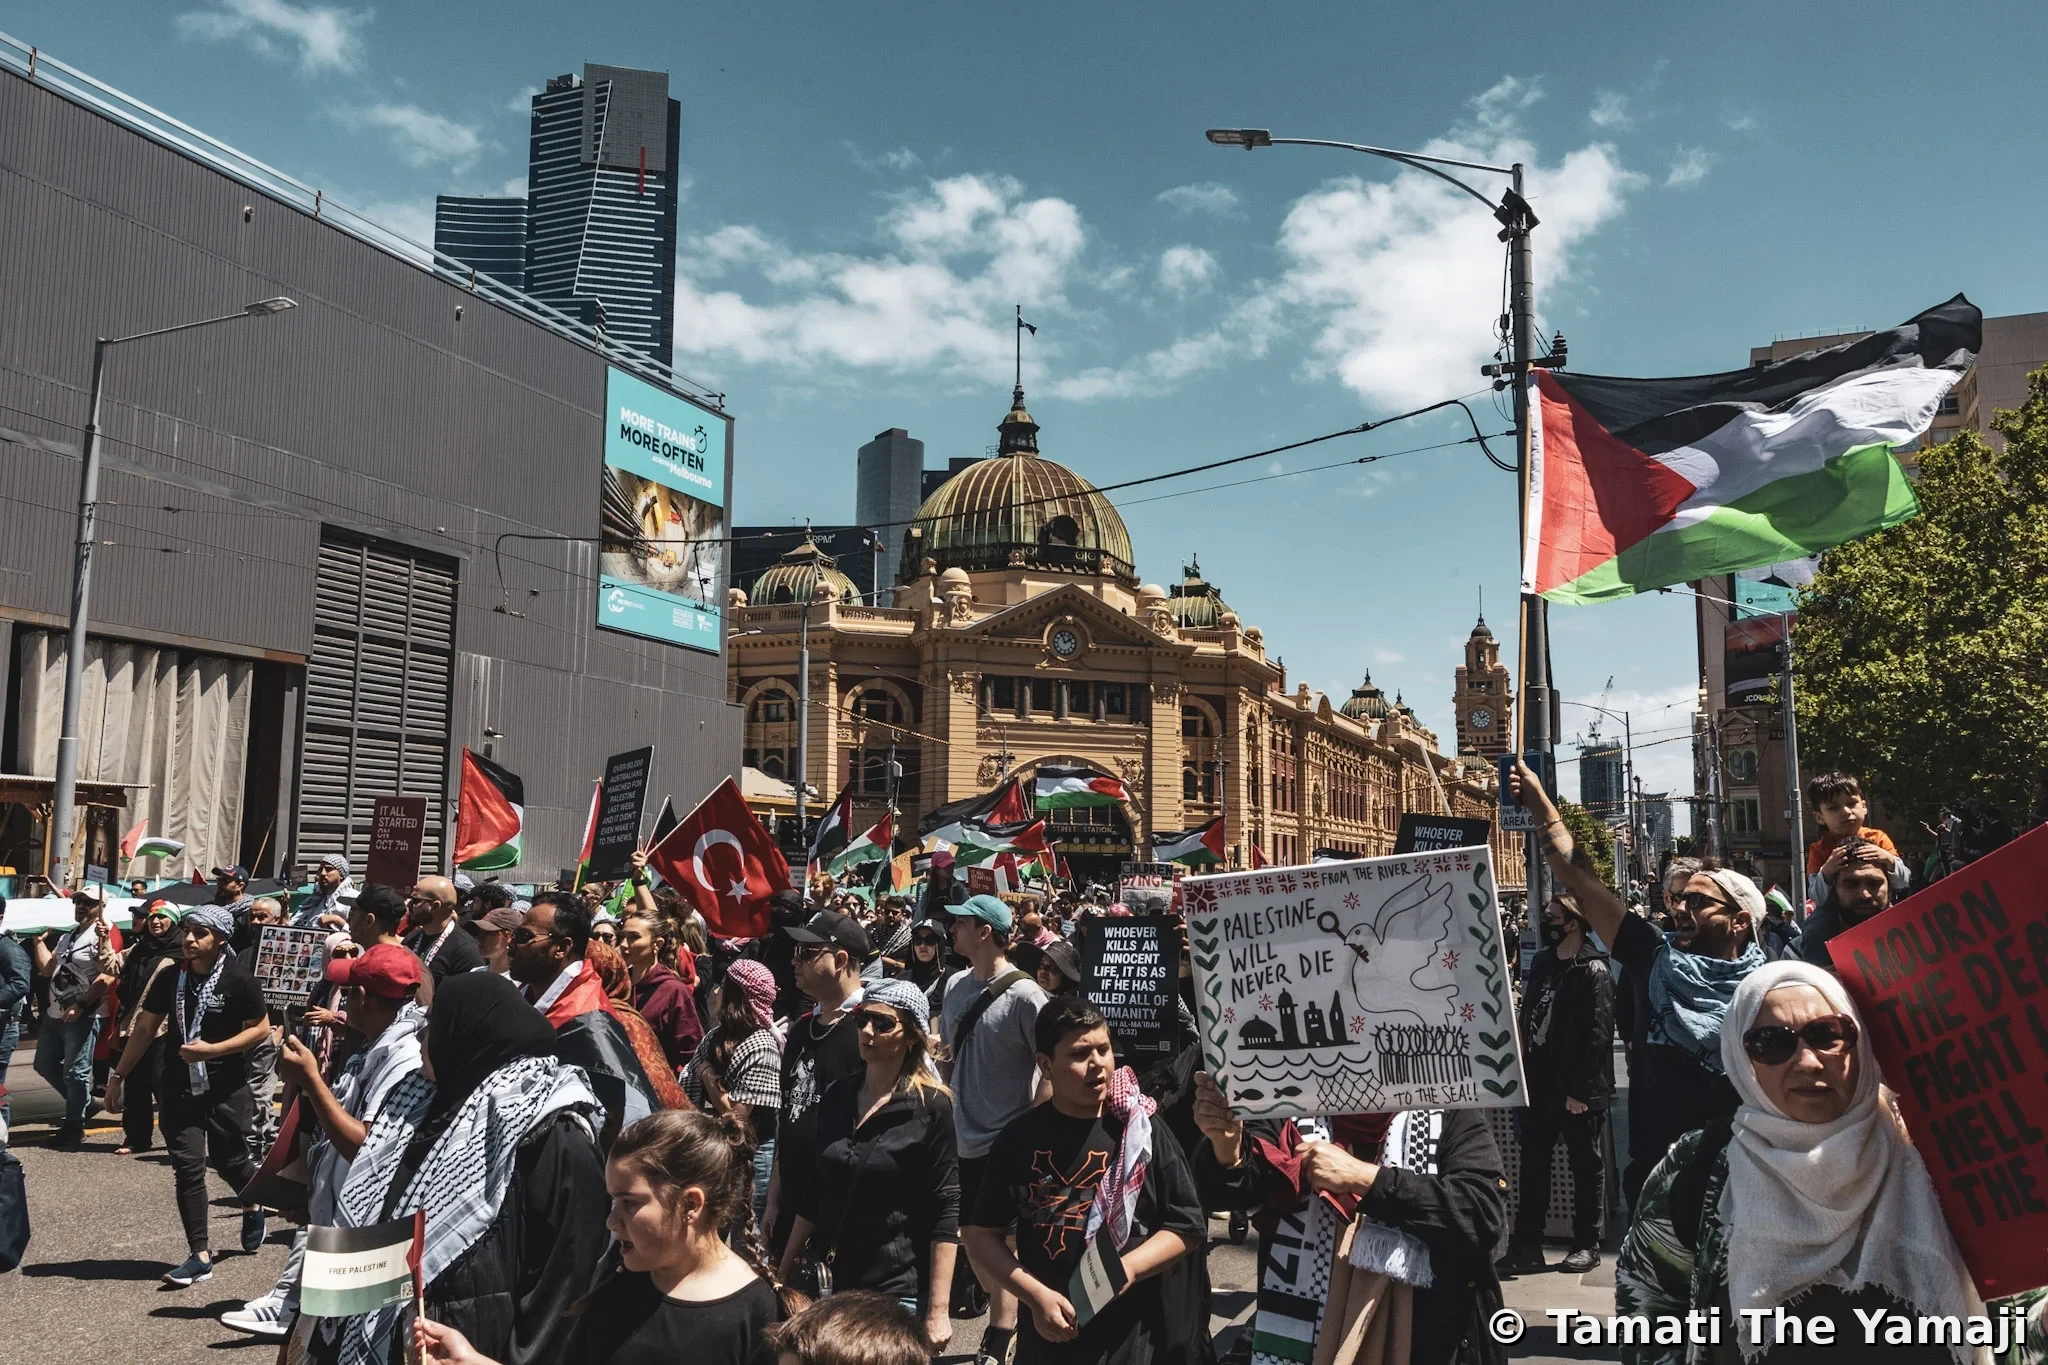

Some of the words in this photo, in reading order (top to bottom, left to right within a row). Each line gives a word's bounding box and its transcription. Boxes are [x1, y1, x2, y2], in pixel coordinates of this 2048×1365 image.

[620, 406, 655, 434] MORE
[656, 422, 697, 451] TRAINS
[620, 423, 660, 454] MORE
[661, 441, 704, 473] OFTEN
[669, 462, 713, 489] Melbourne
[613, 764, 626, 773] OVER
[609, 769, 643, 783] AUSTRALIANS
[606, 782, 631, 793] MARCHED
[631, 779, 643, 788] FOR
[609, 791, 636, 803] PALESTINE
[379, 805, 388, 816] IT
[389, 806, 406, 817] ALL
[607, 805, 620, 814] LAST
[620, 802, 635, 811] WEEK
[1502, 808, 1514, 816] PAY
[378, 816, 418, 829] STARTED
[602, 816, 612, 825] AND
[1503, 816, 1526, 827] AREA
[376, 827, 390, 839] ON
[600, 826, 614, 836] EVEN
[615, 824, 629, 833] MAKE
[1414, 825, 1464, 842] WHOEVER
[375, 839, 393, 851] OCT
[607, 836, 616, 844] THE
[1122, 863, 1173, 876] CHILDREN
[1321, 869, 1350, 886] FROM
[1353, 866, 1373, 881] THE
[1377, 862, 1411, 881] RIVER
[1223, 897, 1316, 942] PALESTINE
[1104, 926, 1157, 938] WHOEVER
[1853, 880, 2010, 996] MOURN
[1105, 939, 1138, 952] KILLS
[1141, 940, 1159, 952] AN
[1102, 953, 1161, 965] INNOCENT
[1229, 942, 1278, 973] WILL
[1093, 965, 1120, 979] LIFE,
[1122, 966, 1135, 978] IT
[1136, 966, 1148, 978] IS
[1150, 966, 1167, 978] AS
[1231, 963, 1292, 1003] NEVER
[1299, 950, 1334, 978] DIE
[1101, 979, 1113, 991] IF
[1114, 979, 1130, 991] HE
[1131, 980, 1157, 992] HAS
[1087, 992, 1126, 1005] KILLED
[1128, 994, 1151, 1006] ALL
[1153, 995, 1169, 1007] OF
[1100, 1007, 1158, 1020] UMANITY
[1876, 971, 1967, 1050] THE
[1117, 1028, 1138, 1036] (5:32)
[1904, 1013, 2026, 1113] FIGHT
[1393, 1091, 1413, 1106] TO
[1415, 1086, 1440, 1104] THE
[1441, 1082, 1479, 1104] SEA!!
[1930, 1089, 2043, 1171] HELL
[1950, 1155, 2048, 1227] THE
[329, 1267, 347, 1275] FREE
[349, 1261, 388, 1274] PALESTINE
